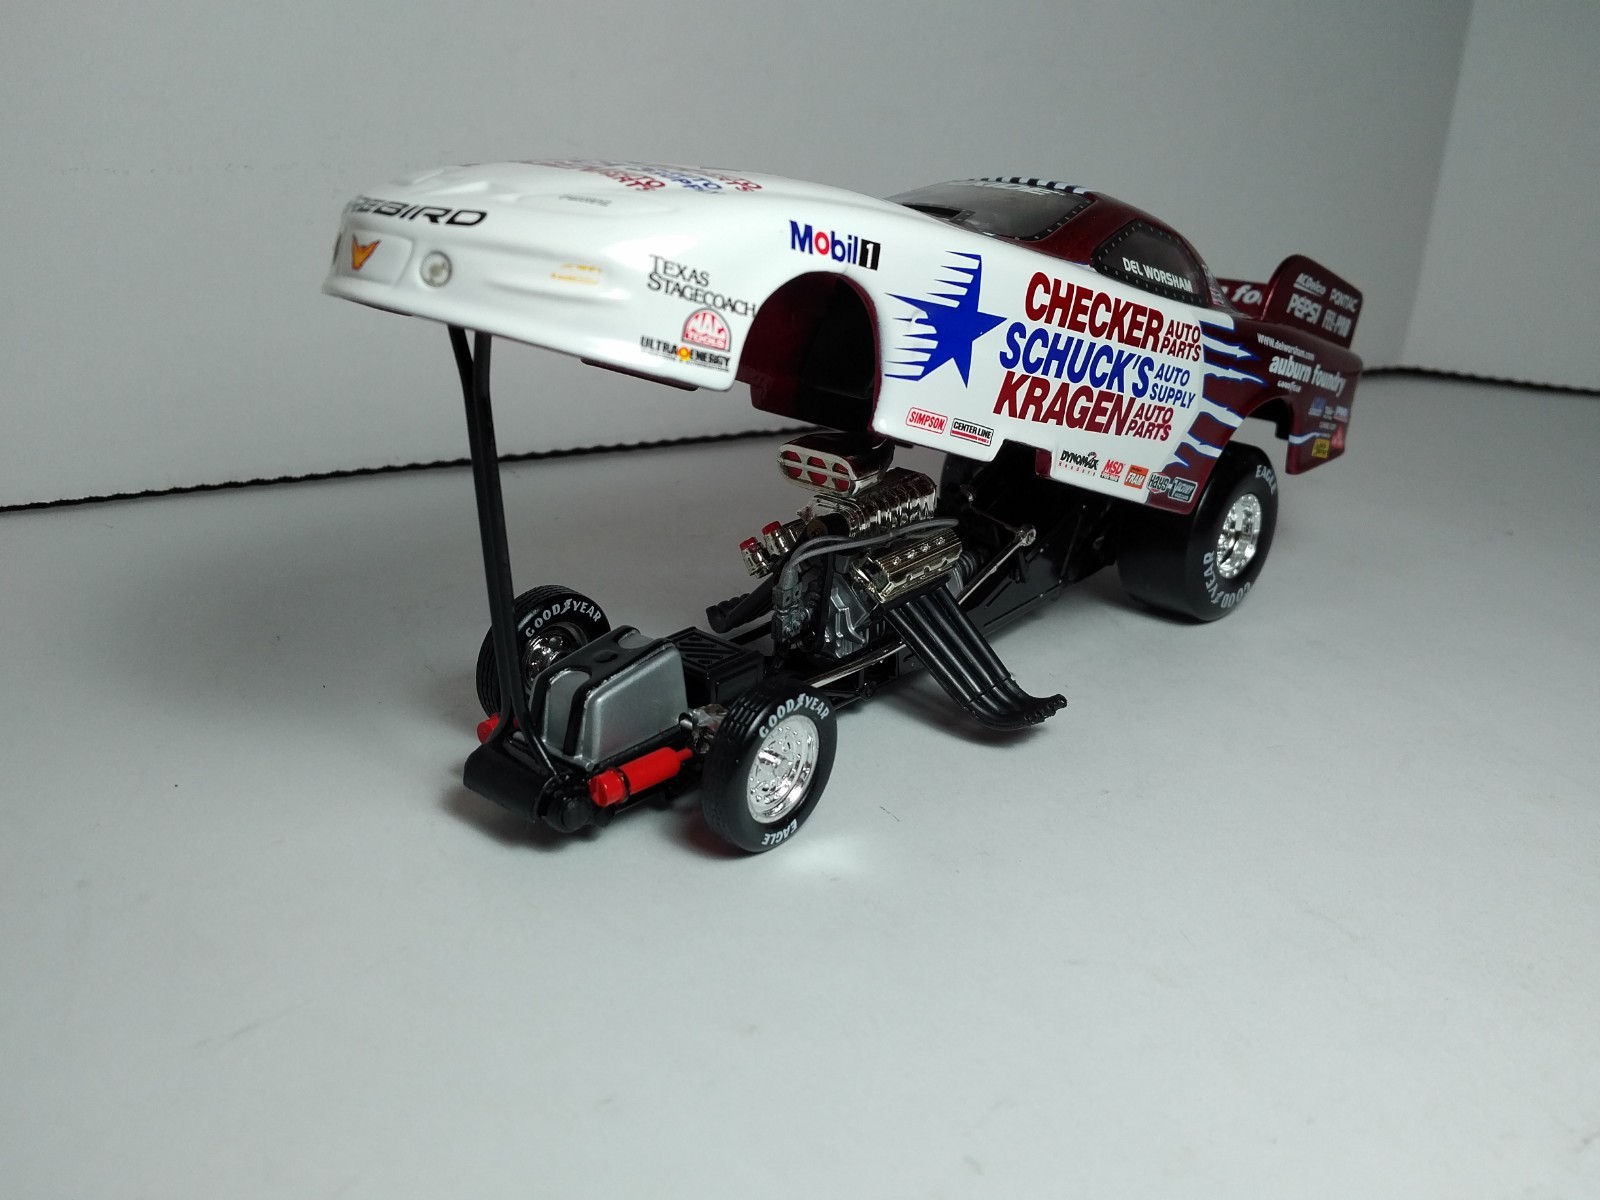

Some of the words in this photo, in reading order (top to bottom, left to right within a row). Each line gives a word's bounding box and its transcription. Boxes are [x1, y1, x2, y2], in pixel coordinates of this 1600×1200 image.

[789, 219, 858, 265] Mobil
[649, 253, 710, 287] TEXAS
[1122, 257, 1143, 276] DEL
[1143, 264, 1193, 293] WORSHAM
[647, 272, 756, 318] STAGECOACH
[1286, 293, 1322, 325] PEPSI
[1329, 287, 1359, 313] PONTIAC
[1024, 271, 1164, 352] CHECKER
[1164, 319, 1201, 343] AUTO
[641, 335, 677, 355] ULTRA
[689, 349, 730, 367] ENERGY
[999, 321, 1154, 399] SCHUCK'S
[1159, 340, 1201, 363] PARTS
[1154, 363, 1190, 386] AUTO
[1269, 355, 1312, 383] auburn
[1311, 363, 1346, 398] foundry
[993, 370, 1136, 437] KRAGEN
[1149, 384, 1196, 409] SUPPLY
[909, 411, 945, 430] SIMPSON
[1134, 402, 1174, 425] AUTO
[953, 421, 977, 435] CENTER
[977, 427, 992, 439] LINE
[1125, 418, 1172, 442] PARTS
[1102, 459, 1124, 475] MSD
[1126, 472, 1145, 486] FRAM
[1255, 464, 1278, 495] EAGLE
[525, 598, 602, 638] GOODYEAR
[759, 693, 830, 738] GOODYEAR
[761, 818, 798, 846] EAGLE
